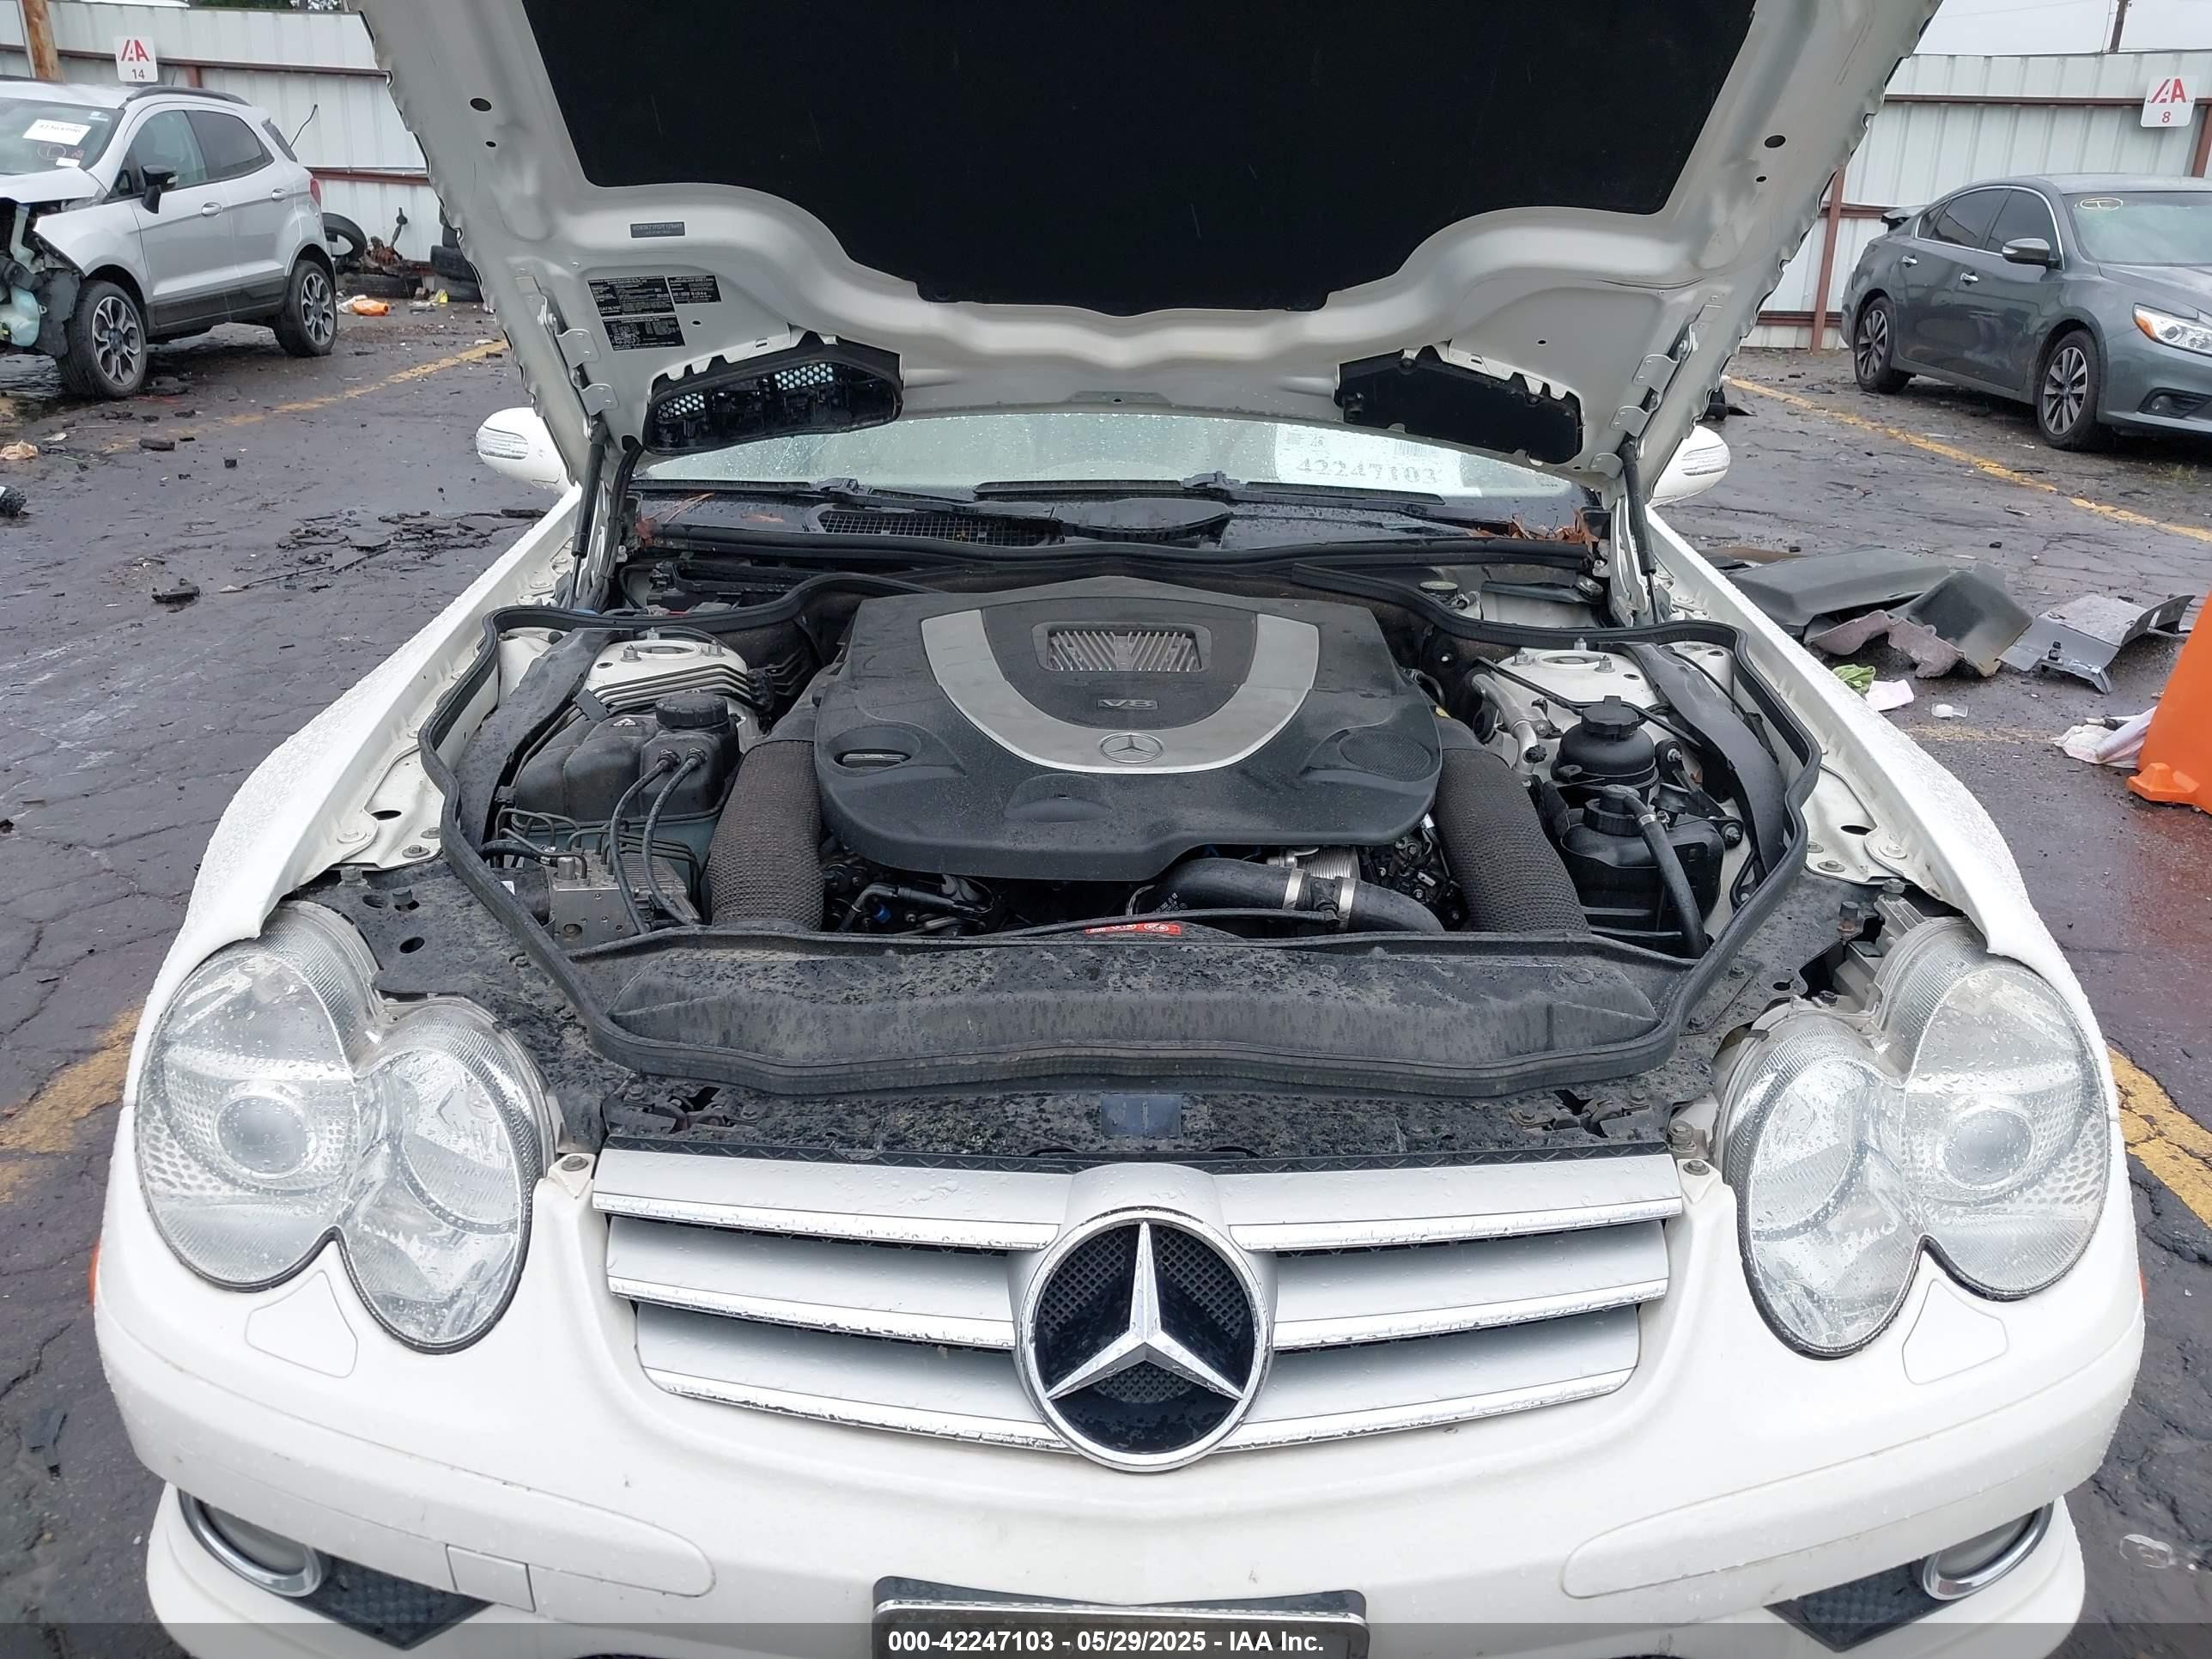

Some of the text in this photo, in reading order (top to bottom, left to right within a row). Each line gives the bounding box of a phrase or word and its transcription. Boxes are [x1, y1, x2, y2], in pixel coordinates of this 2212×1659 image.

[131, 68, 145, 80] 14
[2160, 111, 2172, 124] 8
[1102, 699, 1154, 708] V8
